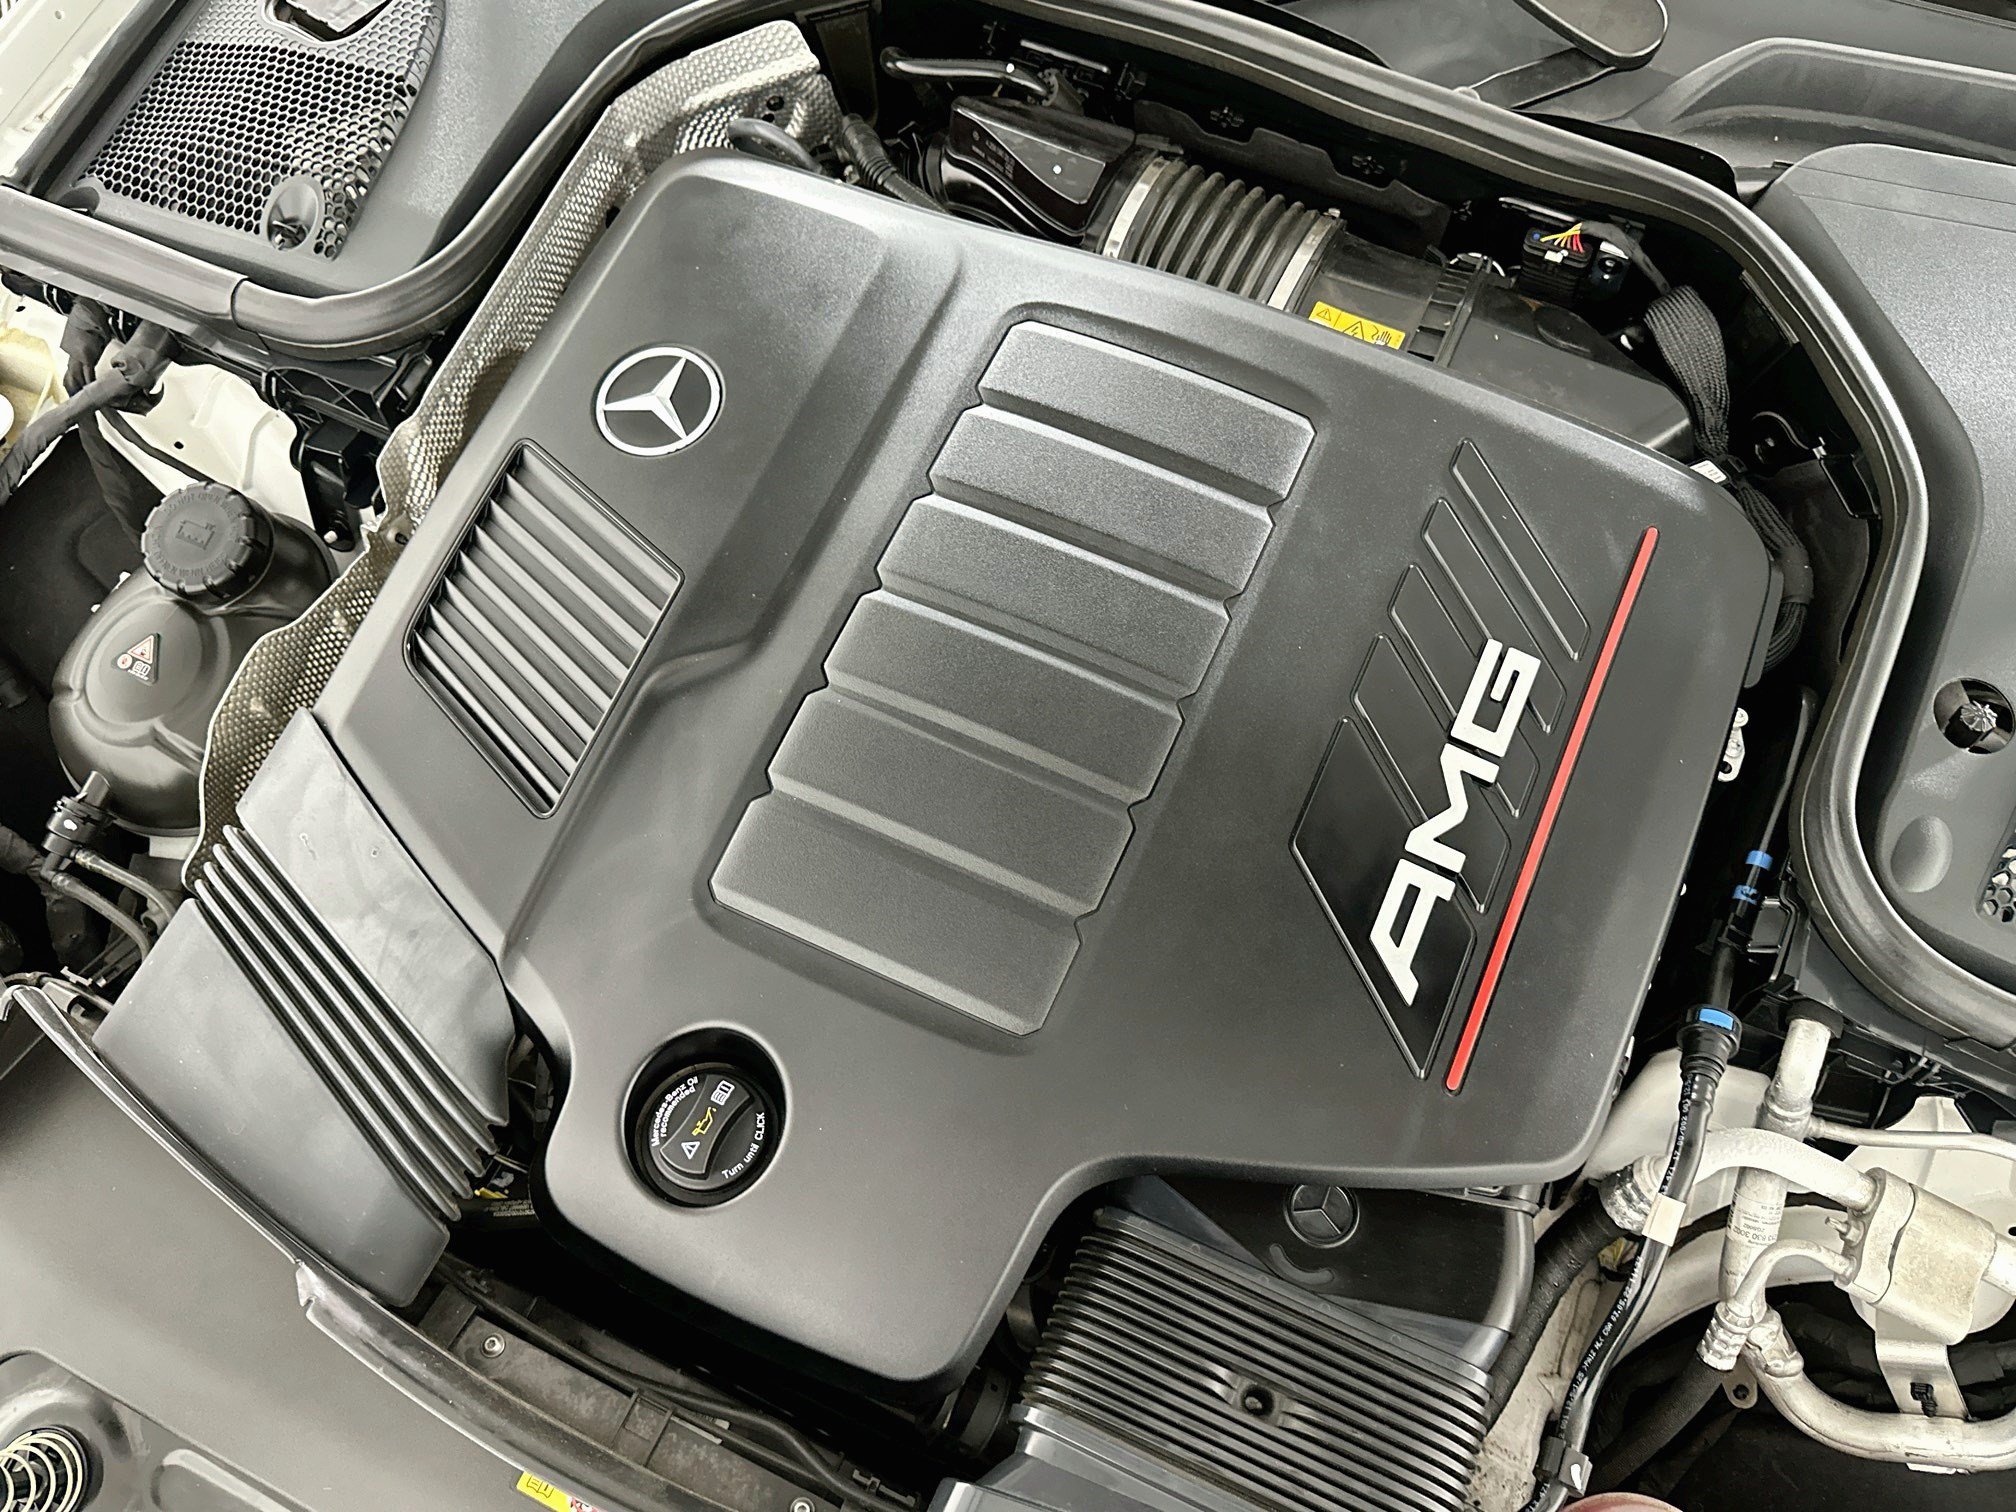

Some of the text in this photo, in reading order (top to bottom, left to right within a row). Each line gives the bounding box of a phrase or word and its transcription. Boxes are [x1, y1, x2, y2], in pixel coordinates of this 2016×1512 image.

[1369, 638, 1541, 1006] AMG
[650, 1083, 687, 1147] Mercedes-Benz
[660, 1085, 696, 1138] recommended
[721, 1112, 766, 1179] Turn until CLICK
